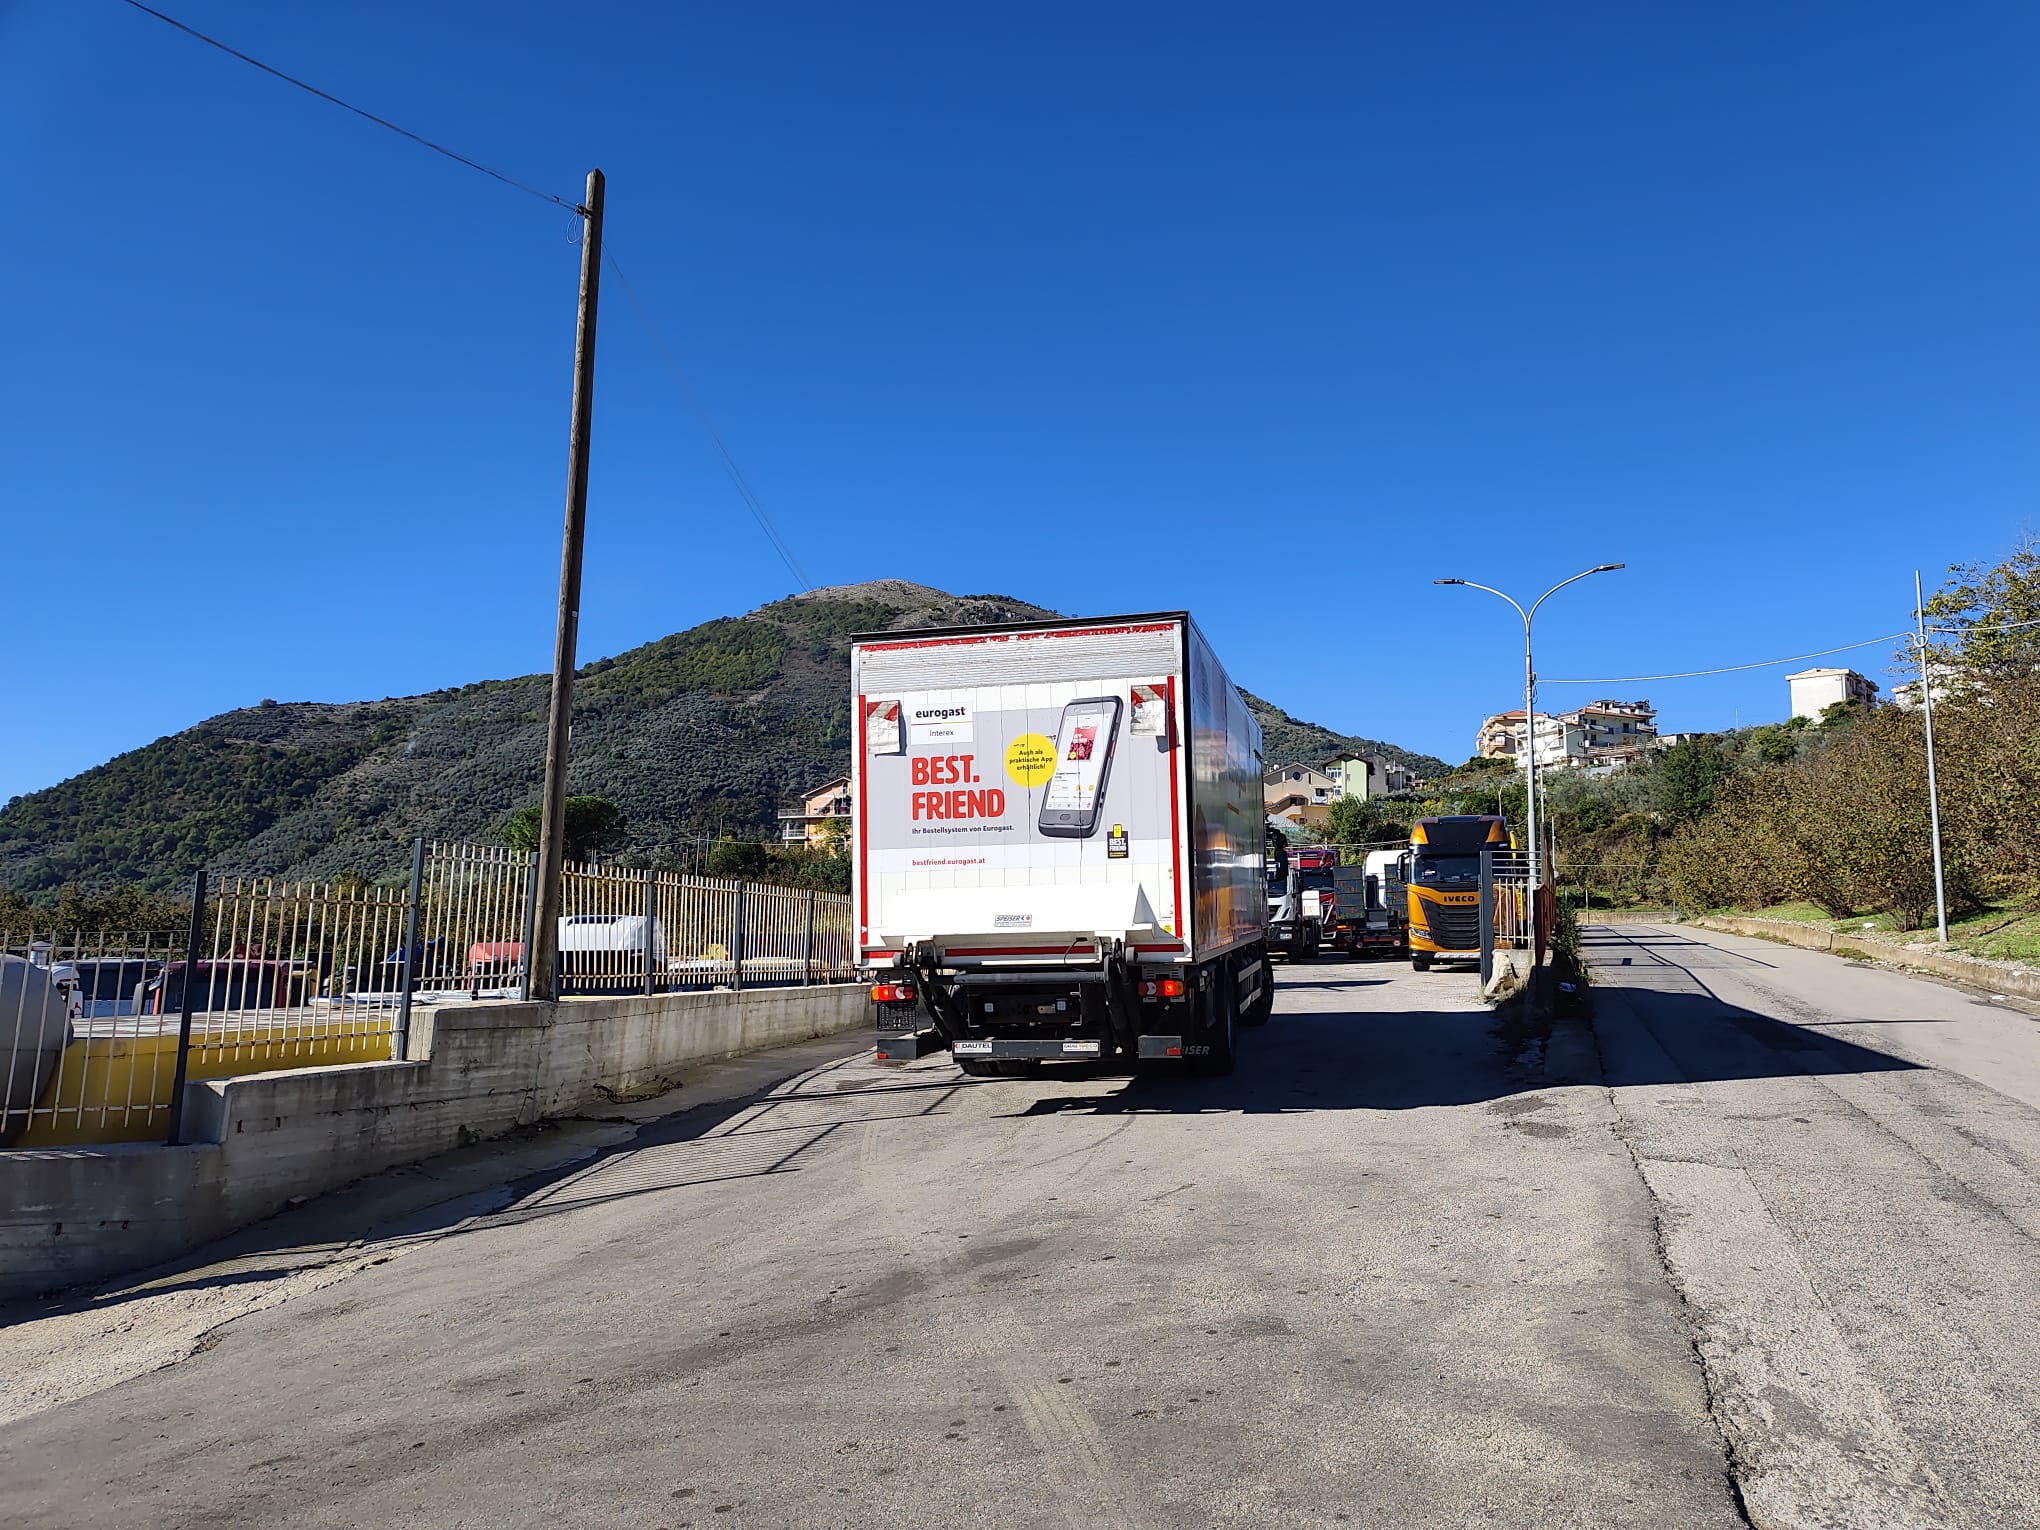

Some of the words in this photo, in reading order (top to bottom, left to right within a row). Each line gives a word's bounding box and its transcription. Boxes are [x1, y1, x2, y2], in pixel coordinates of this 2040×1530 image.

[915, 706, 966, 719] eurogast
[929, 729, 954, 737] Interex
[1018, 749, 1034, 757] Auch
[1008, 757, 1040, 765] praktische
[911, 755, 980, 785] BEST.
[1016, 763, 1046, 772] erhältlich!
[912, 789, 1005, 820] FRIEND
[922, 826, 968, 835] Bestellsystem
[982, 825, 1014, 833] Eurogast.
[911, 857, 986, 867] bestfriend.eurogast.at
